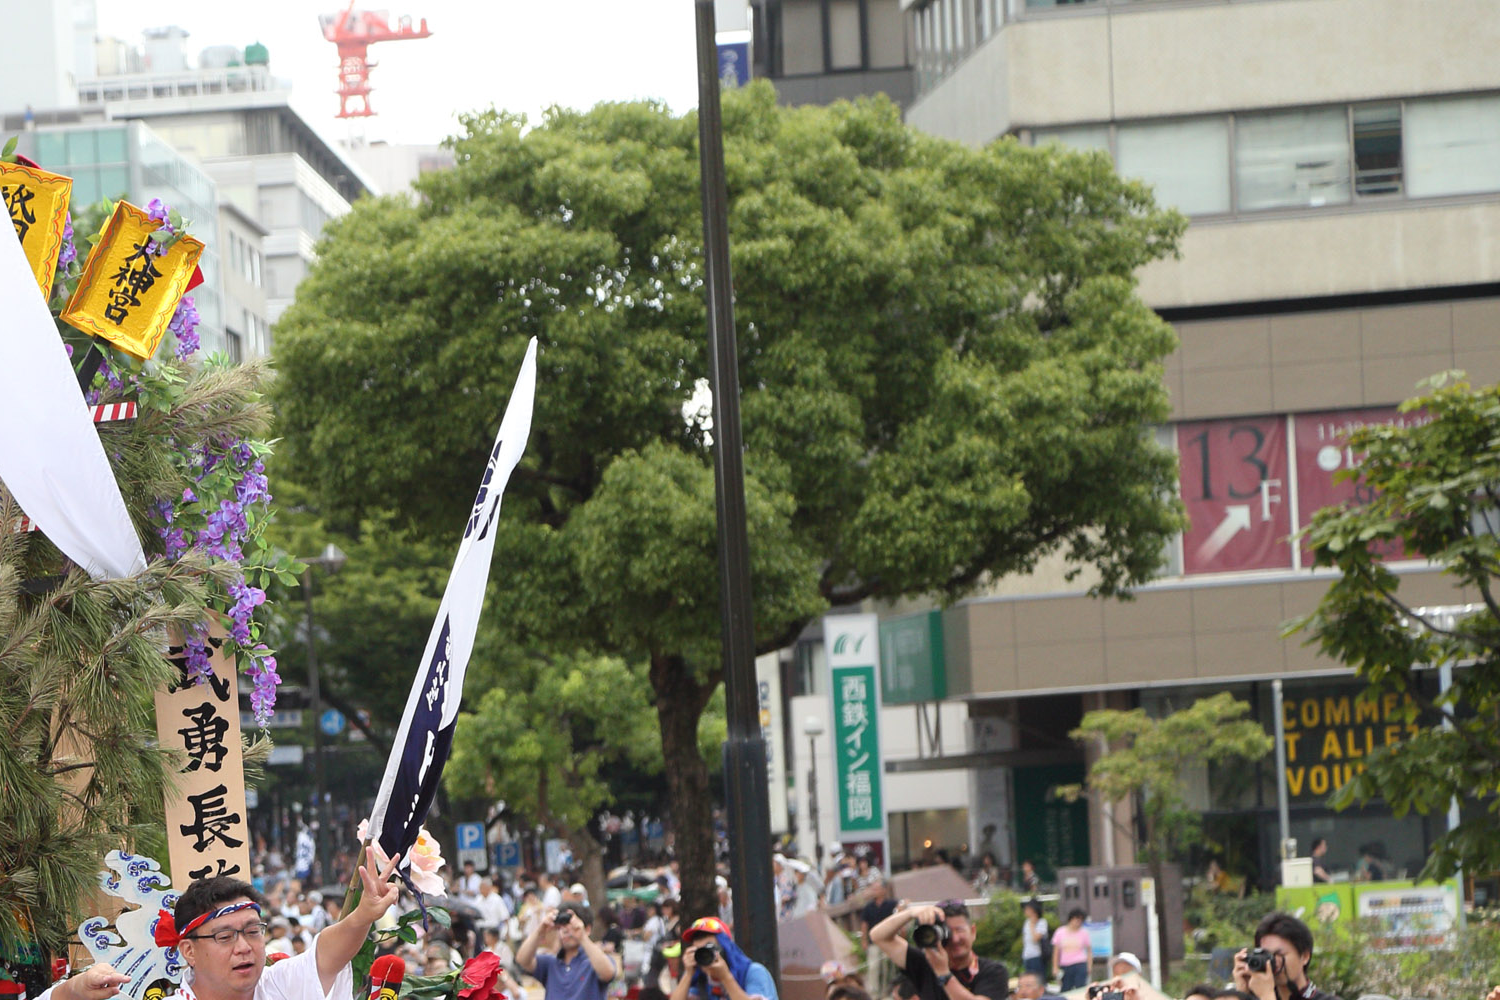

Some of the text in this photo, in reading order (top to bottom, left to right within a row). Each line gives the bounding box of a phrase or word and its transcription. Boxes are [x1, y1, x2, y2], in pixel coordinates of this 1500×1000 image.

[840, 674, 873, 822] 西鉄イン福岡
